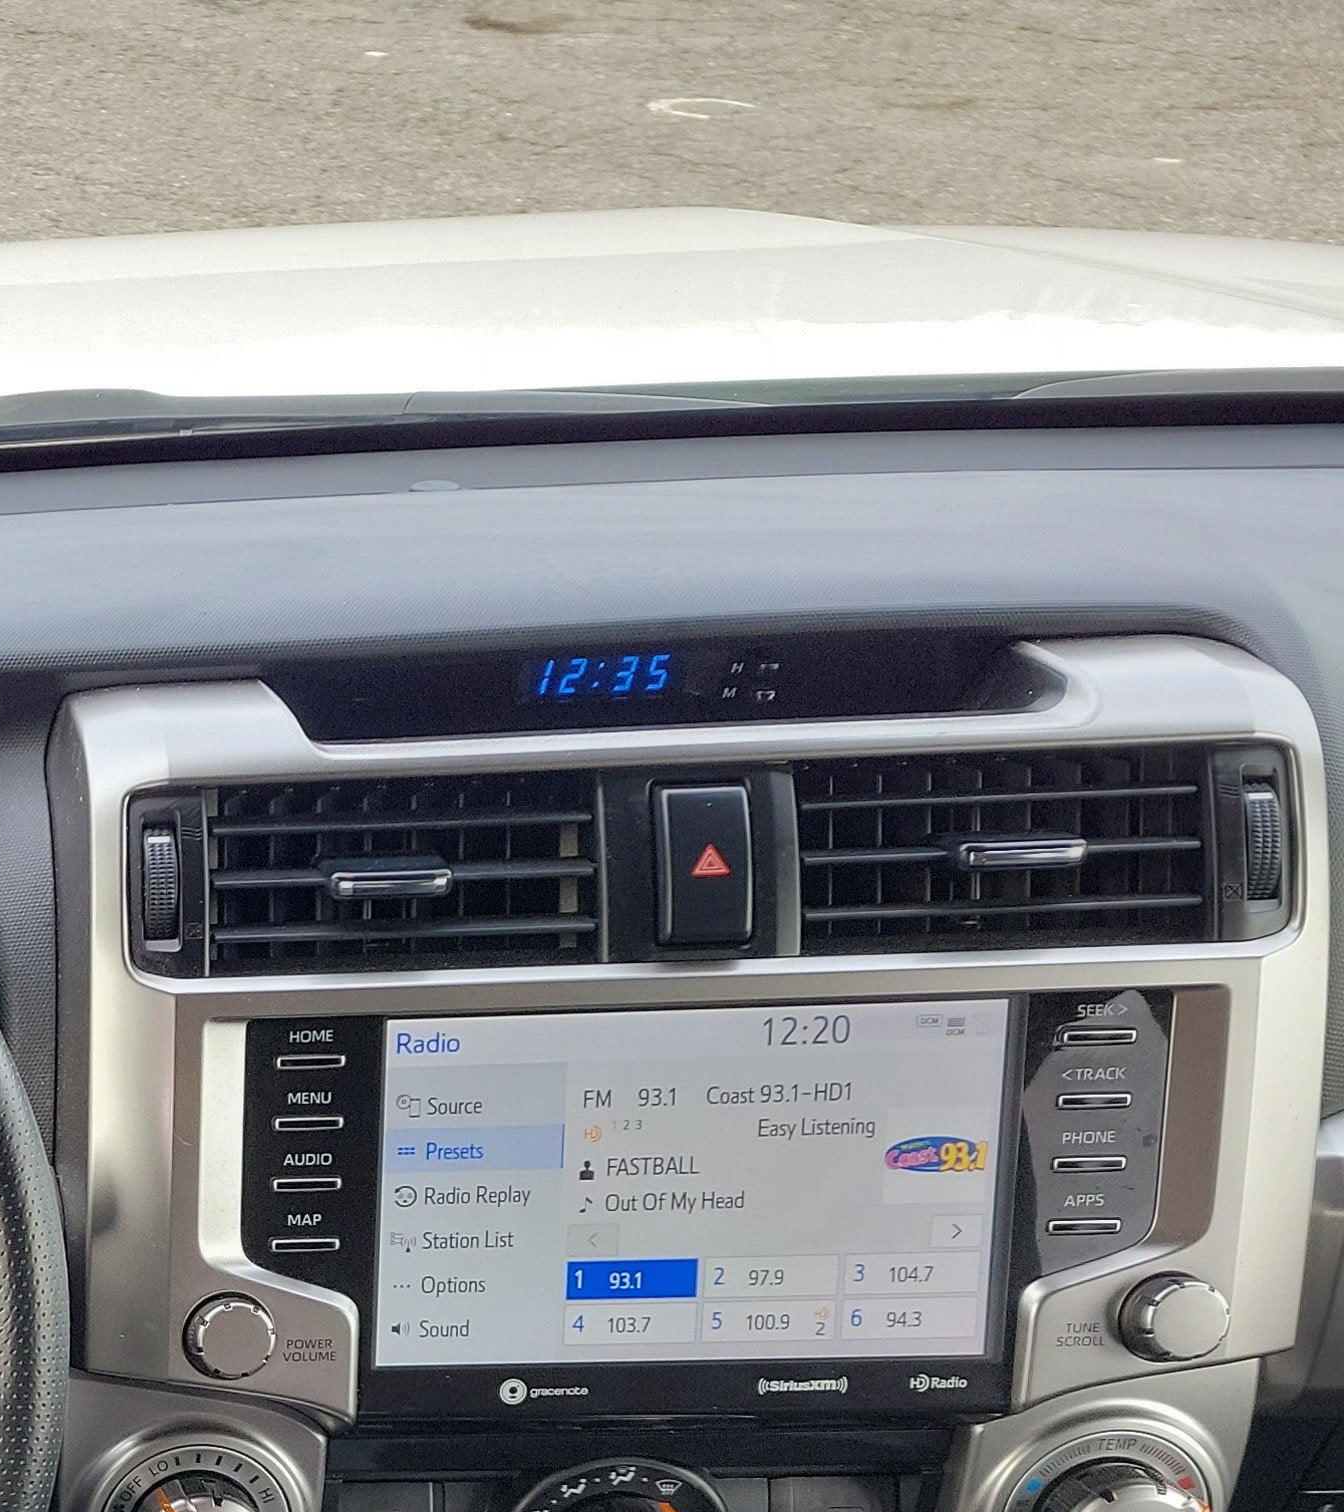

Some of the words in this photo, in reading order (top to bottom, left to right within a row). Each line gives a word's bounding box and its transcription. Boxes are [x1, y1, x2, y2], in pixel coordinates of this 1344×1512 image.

[537, 654, 670, 695] 12:35
[729, 662, 744, 674] H
[721, 687, 737, 699] M
[289, 1030, 334, 1043] HOME
[396, 1032, 460, 1055] Radio
[763, 1014, 851, 1046] 12:20
[287, 1091, 332, 1105] MENU
[583, 1089, 612, 1108] FM
[638, 1087, 677, 1107] 93.1
[707, 1086, 755, 1105] Coast
[760, 1082, 852, 1103] 93.1-HD1
[427, 1097, 483, 1115] Source
[623, 1120, 630, 1131] 2
[635, 1119, 643, 1130] 3
[758, 1118, 797, 1140] Easy
[801, 1117, 876, 1139] Listening
[1062, 1131, 1117, 1144] PHONE
[283, 1153, 333, 1166] AUDIO
[426, 1142, 484, 1160] Presets
[939, 1141, 989, 1172] 93.1
[607, 1156, 700, 1176] FASTBALL
[424, 1187, 471, 1205] Radio
[476, 1185, 531, 1208] Replay
[605, 1194, 638, 1212] Out
[642, 1192, 666, 1211] Of
[671, 1191, 696, 1214] My
[701, 1190, 745, 1210] Head
[1064, 1194, 1105, 1207] APPS
[287, 1214, 322, 1227] MAP
[422, 1232, 479, 1249] Station
[485, 1230, 514, 1248] List
[574, 1269, 583, 1289] 1
[609, 1272, 642, 1290] 93.1
[714, 1267, 725, 1285] 2
[749, 1269, 784, 1286] 97.9
[854, 1263, 865, 1282] 3
[889, 1265, 934, 1283] 104.7
[421, 1276, 486, 1297] Options
[572, 1314, 585, 1332] 4
[608, 1316, 651, 1333] 103.7
[712, 1312, 723, 1330] 5
[747, 1314, 790, 1331] 100.9
[850, 1308, 863, 1327] 6
[886, 1311, 922, 1328] 94.3
[419, 1319, 470, 1338] Sound
[815, 1321, 826, 1336] 2
[1066, 1322, 1100, 1333] TUNE
[286, 1338, 333, 1350] POWER
[1056, 1336, 1106, 1347] SCROLL
[282, 1350, 337, 1363] VOLUME
[529, 1386, 589, 1398] gracenote
[931, 1377, 968, 1390] Radio
[1097, 1438, 1138, 1451] TEMP
[119, 1475, 145, 1502] OFF
[148, 1460, 169, 1477] LO
[258, 1489, 275, 1504] HI
